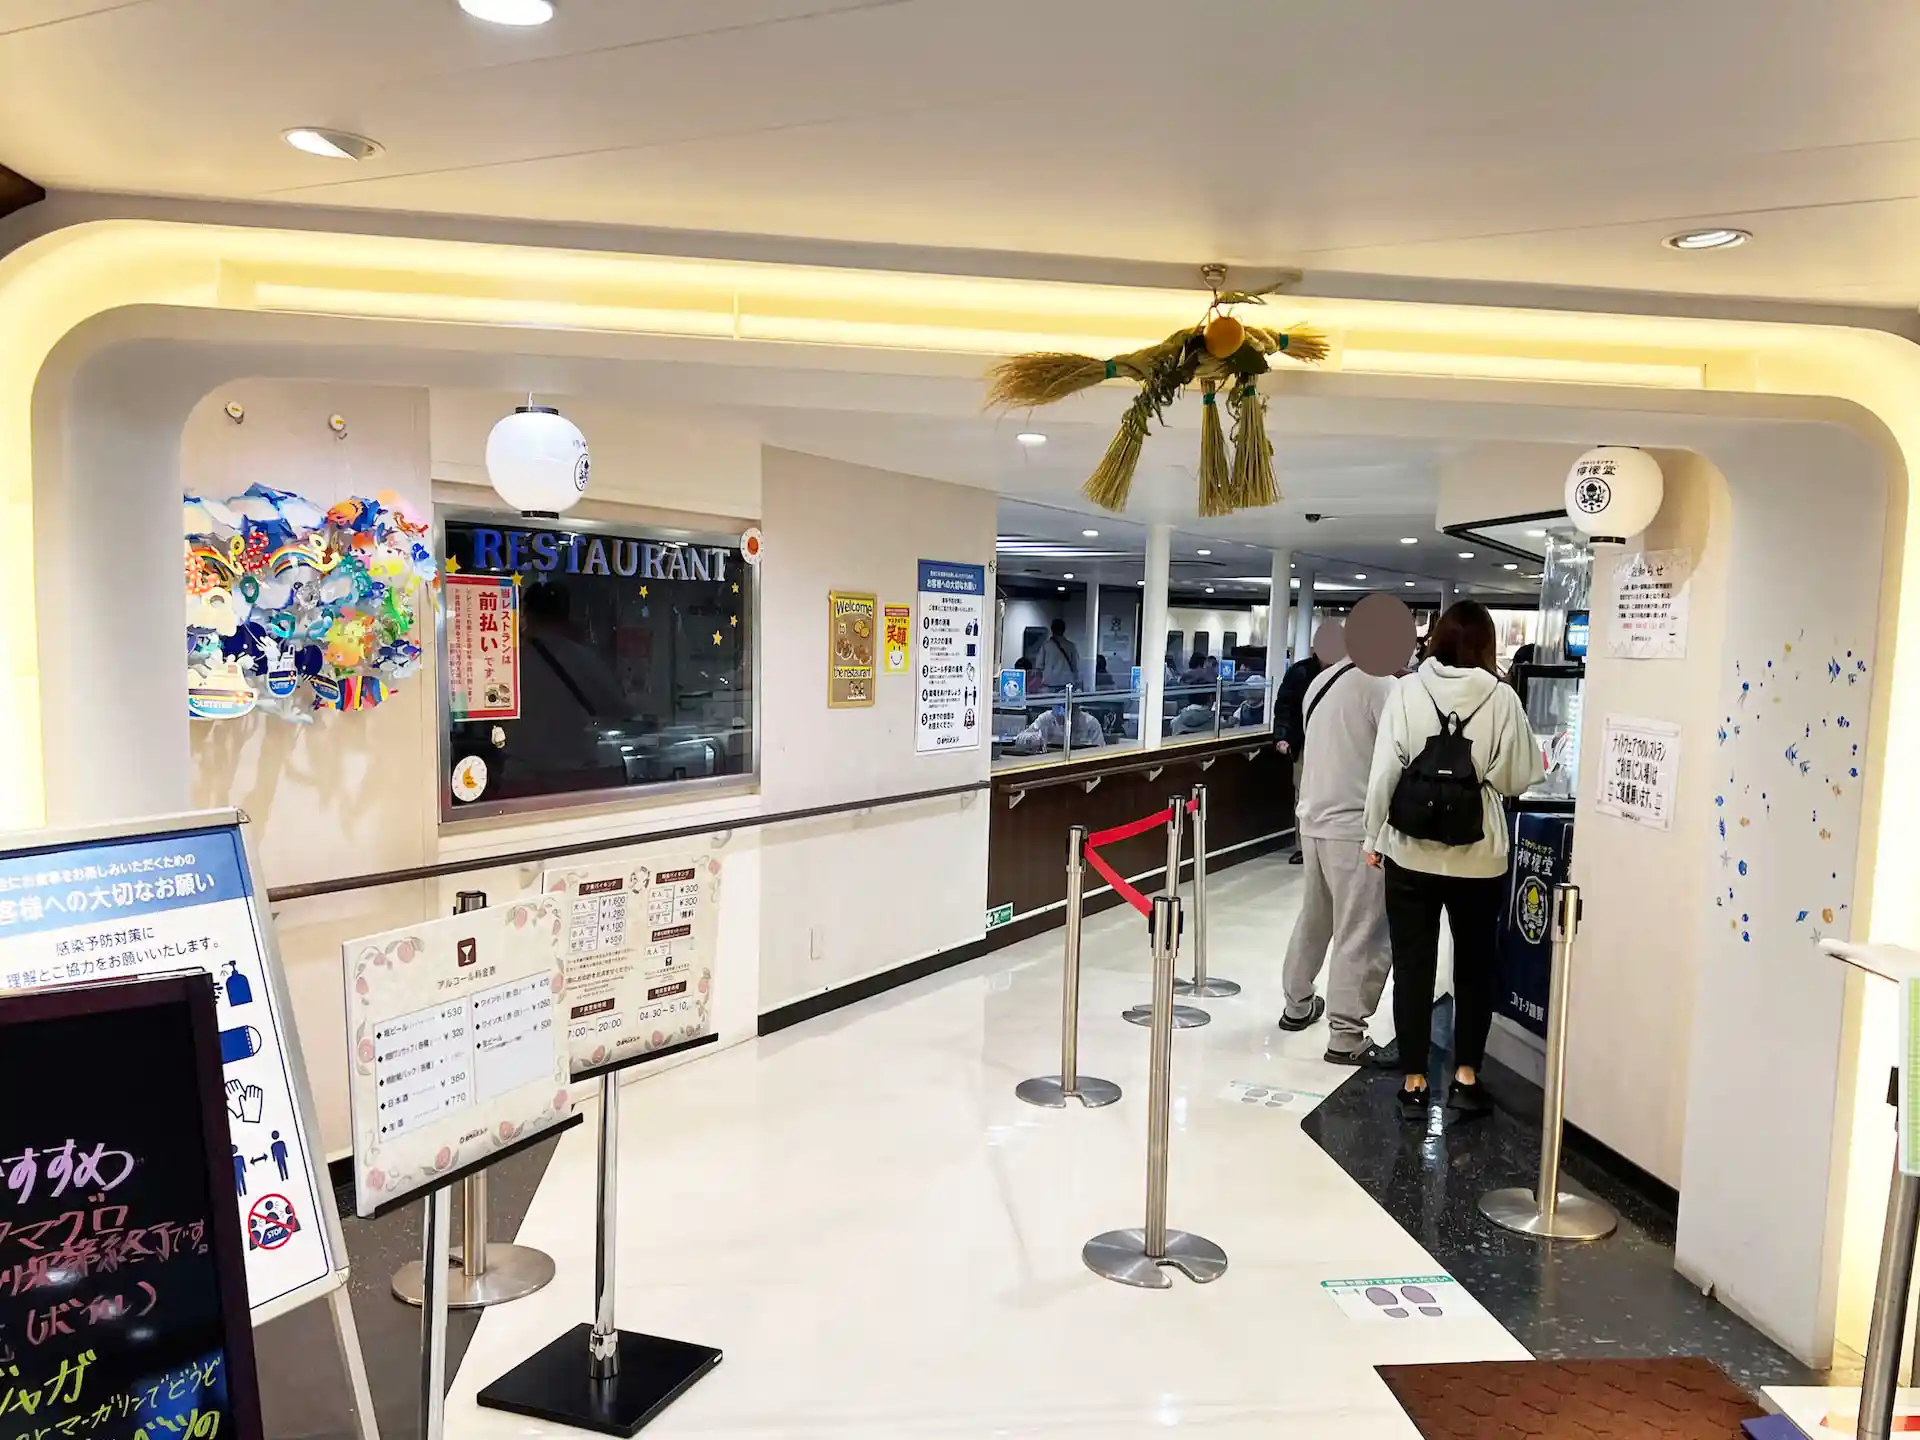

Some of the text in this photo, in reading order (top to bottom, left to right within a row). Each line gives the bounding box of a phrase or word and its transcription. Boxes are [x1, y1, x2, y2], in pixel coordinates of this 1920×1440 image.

[471, 528, 730, 582] RESTAURANT
[500, 587, 512, 665] 当レストランは
[836, 599, 872, 617] Welcome
[56, 926, 155, 957] 感染予防対策に
[0, 1138, 135, 1205] すすめ
